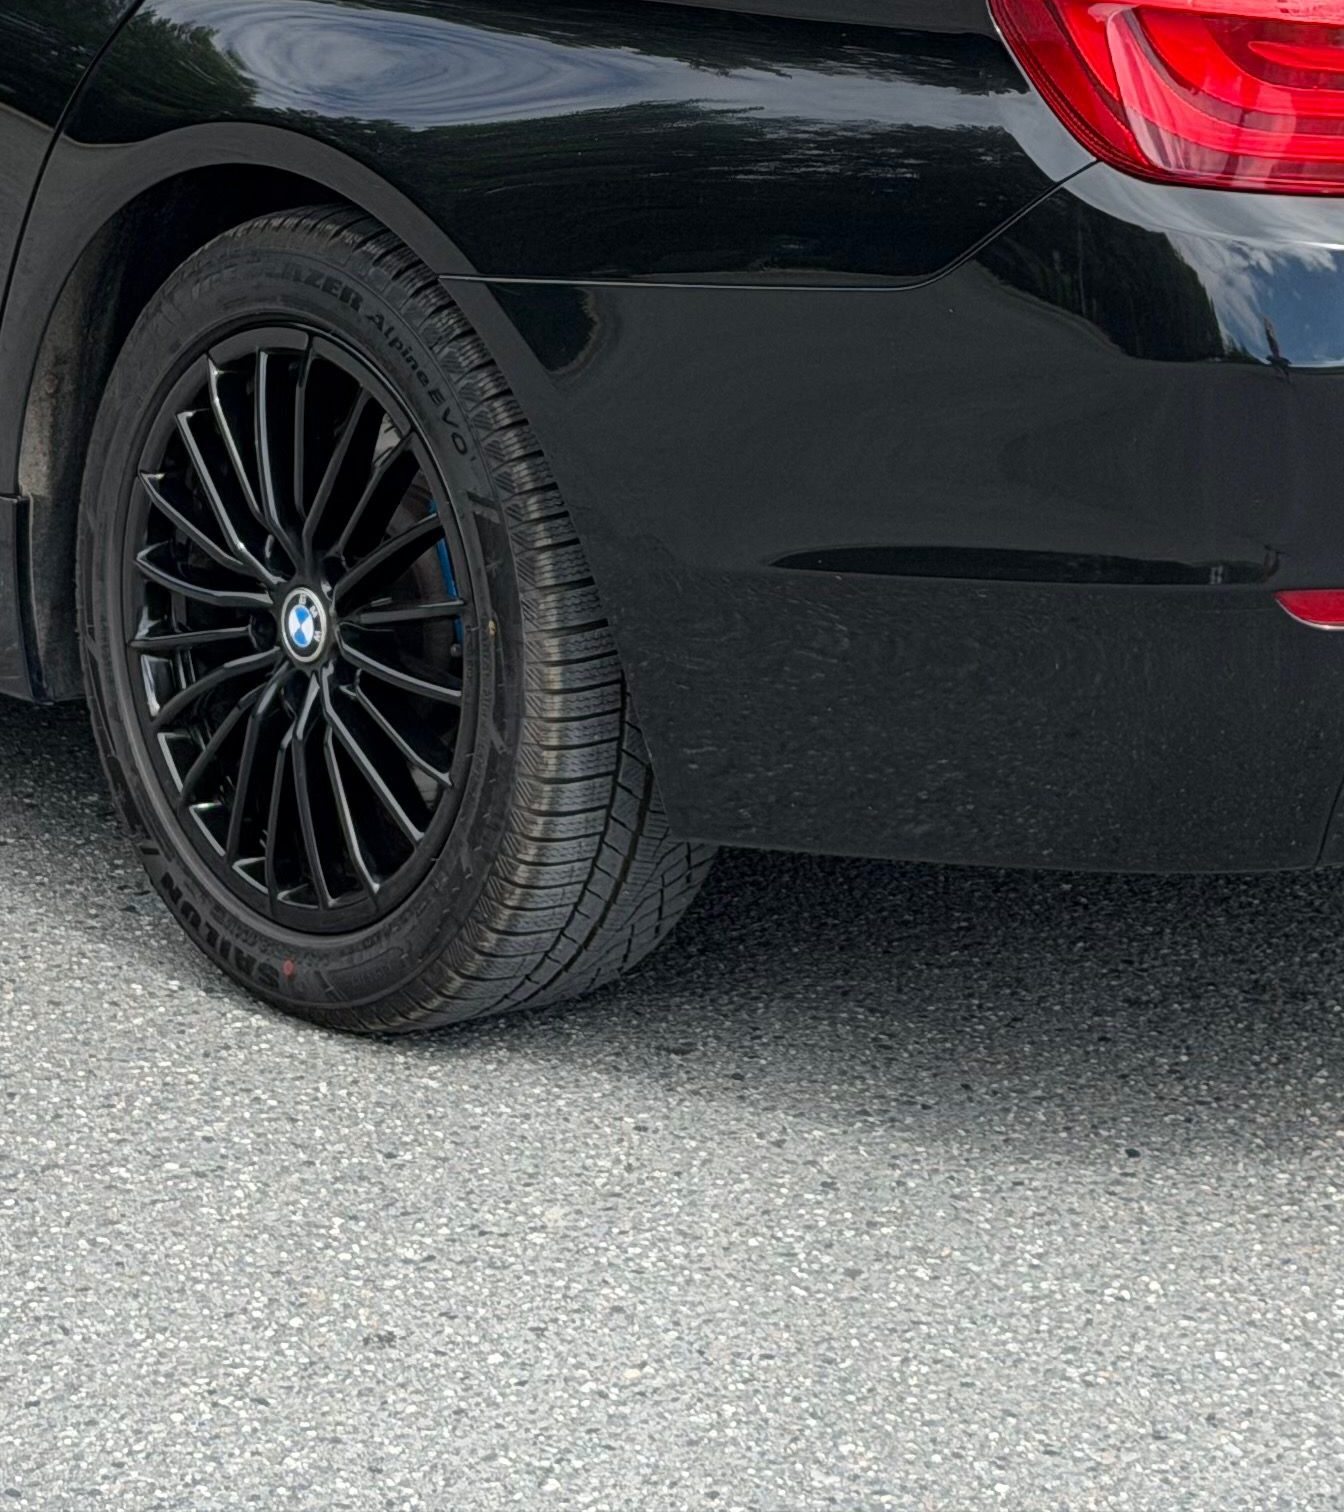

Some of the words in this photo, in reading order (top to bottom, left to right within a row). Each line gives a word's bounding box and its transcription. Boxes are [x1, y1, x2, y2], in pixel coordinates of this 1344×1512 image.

[366, 311, 429, 387] Alpine
[298, 592, 323, 643] BMW
[160, 872, 281, 990] SAILUN
